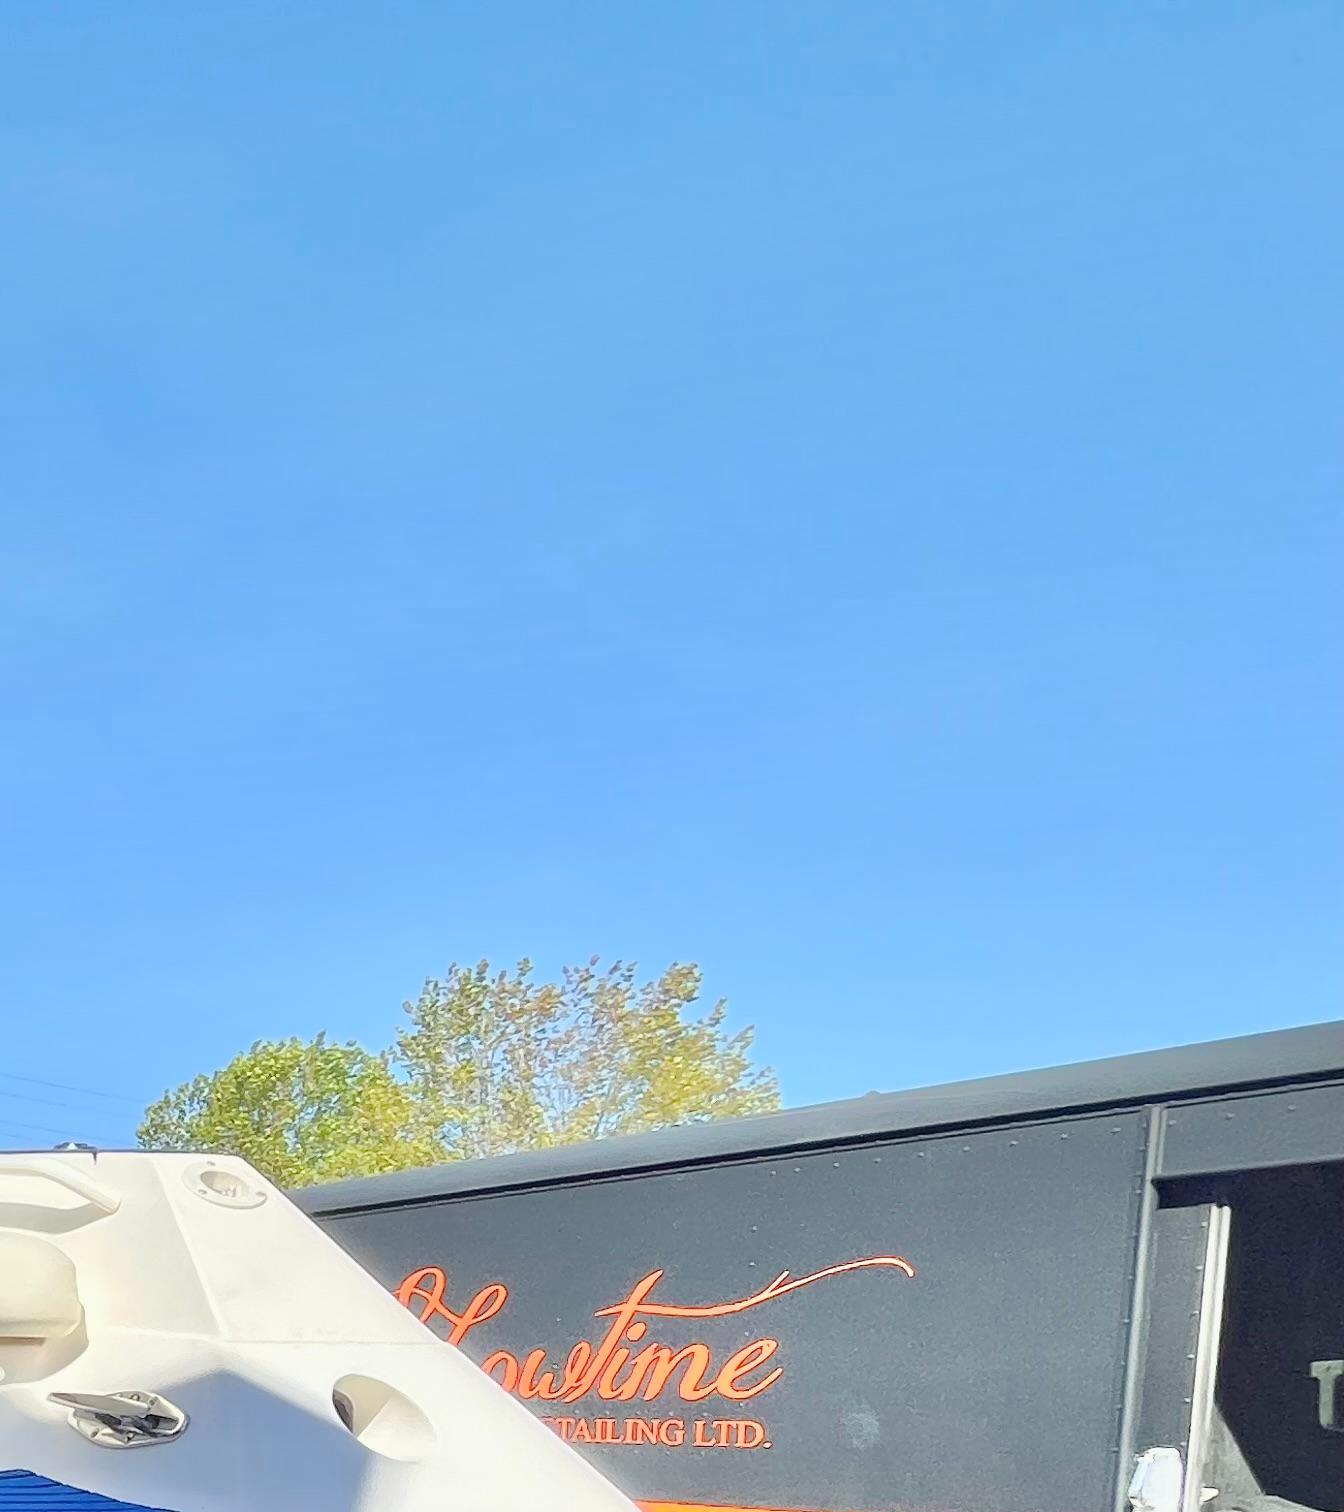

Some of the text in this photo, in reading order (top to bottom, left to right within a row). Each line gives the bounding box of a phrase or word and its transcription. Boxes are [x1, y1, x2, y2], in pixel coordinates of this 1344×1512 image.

[395, 1256, 914, 1404] owtime
[542, 1416, 774, 1449] TAILING LTD.
